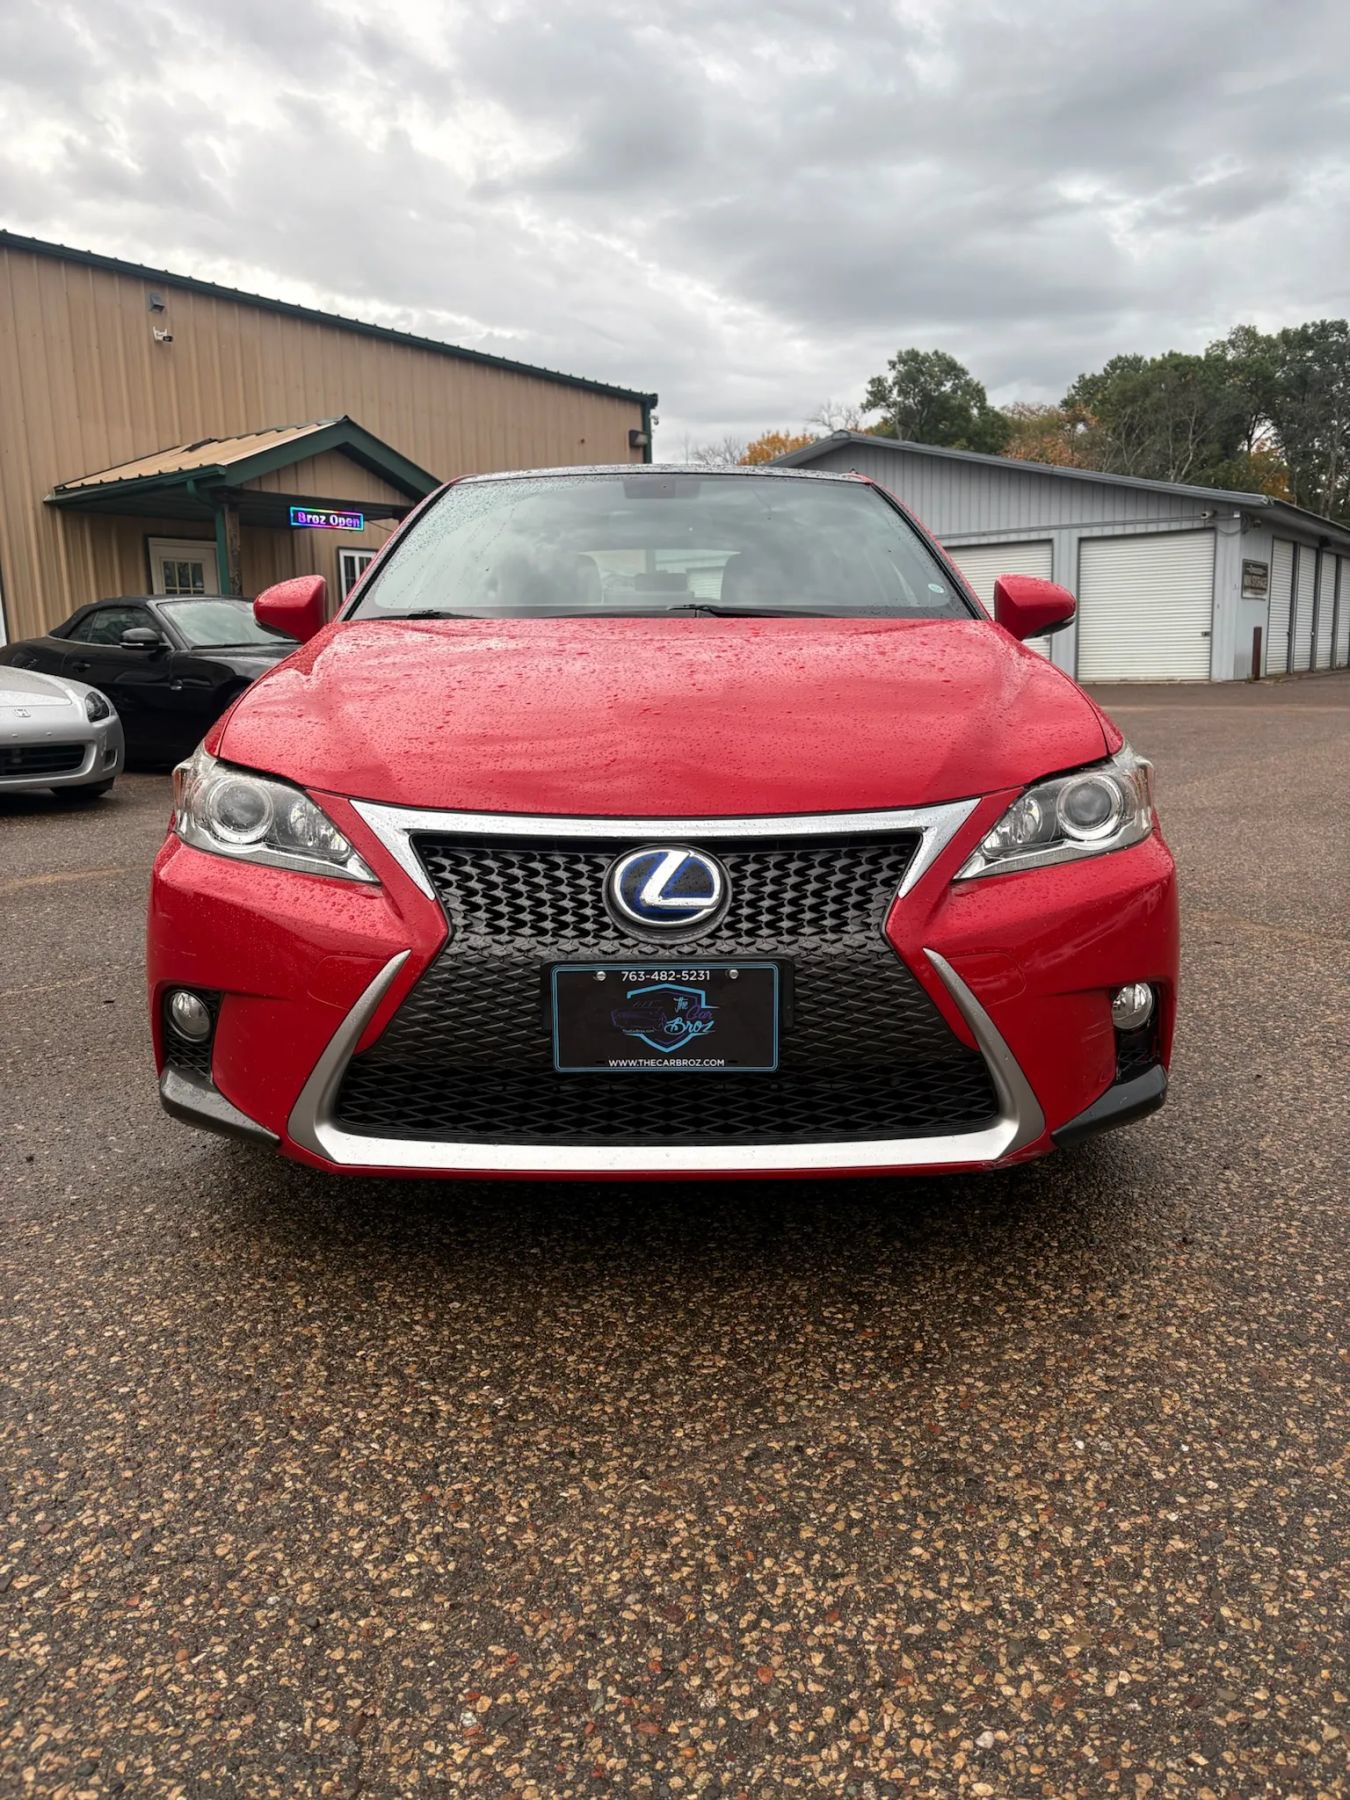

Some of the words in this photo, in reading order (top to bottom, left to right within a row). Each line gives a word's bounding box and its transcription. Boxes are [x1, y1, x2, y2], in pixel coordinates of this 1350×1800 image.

[298, 511, 326, 525] Broz
[329, 514, 360, 528] Open
[621, 970, 711, 982] 763-482-5231
[664, 1017, 715, 1036] Broz
[608, 1058, 725, 1067] WWW.THECARBROZ.COM
